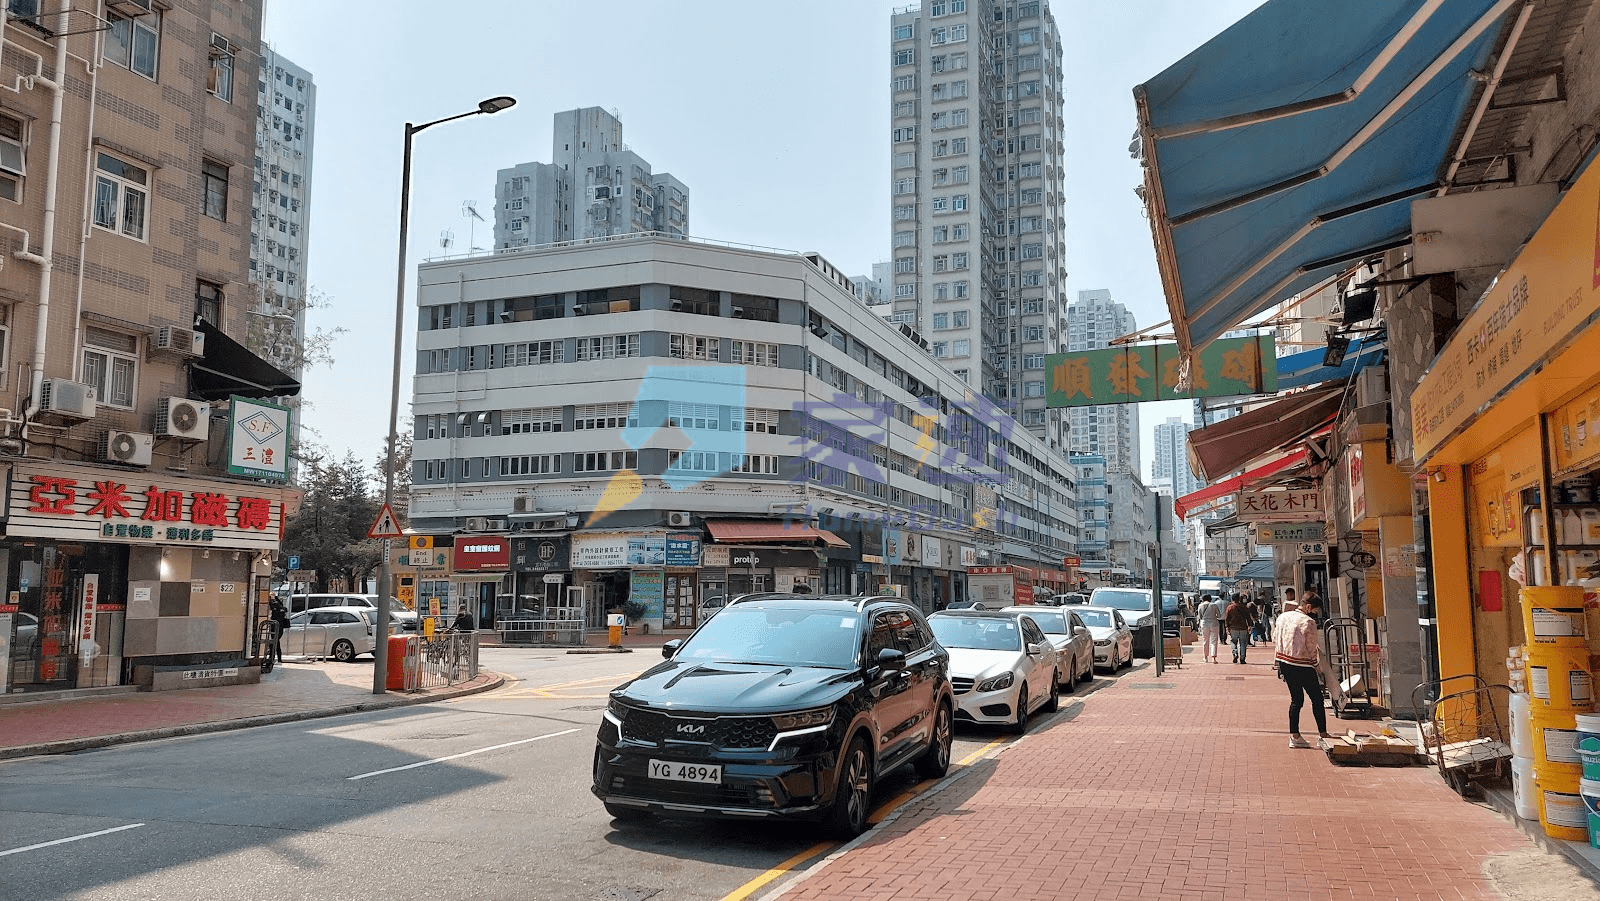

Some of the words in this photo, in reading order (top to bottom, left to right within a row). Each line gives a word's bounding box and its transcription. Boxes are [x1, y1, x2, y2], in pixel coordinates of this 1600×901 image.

[1565, 286, 1583, 314] TRUST
[248, 419, 274, 434] S.F.
[27, 474, 273, 530] 亞米加磁磚
[1302, 543, 1323, 553] 安盛
[290, 557, 298, 568] P
[220, 584, 234, 593] $22
[677, 724, 705, 733] KIA
[652, 763, 671, 777] YG
[678, 766, 718, 781] 4894
